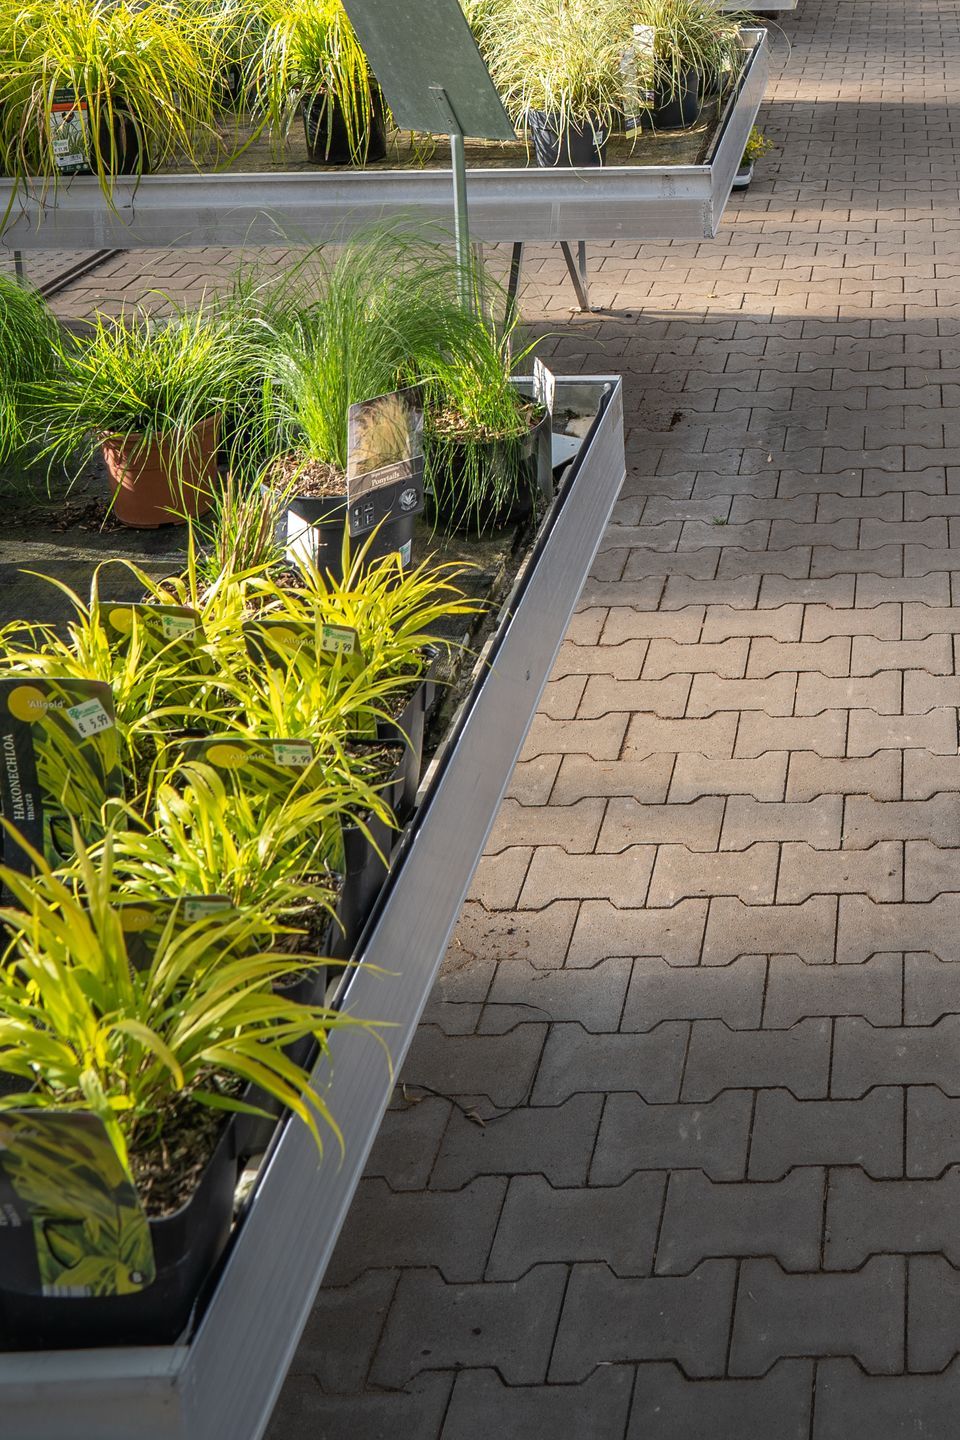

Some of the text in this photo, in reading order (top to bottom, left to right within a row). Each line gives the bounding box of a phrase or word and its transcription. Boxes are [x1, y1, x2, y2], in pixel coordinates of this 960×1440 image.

[371, 471, 400, 487] Ponytails
[27, 700, 65, 709] 'Allgold'
[89, 713, 109, 729] 5.99
[2, 733, 25, 821] HAKONECHLOA
[25, 793, 35, 821] macra
